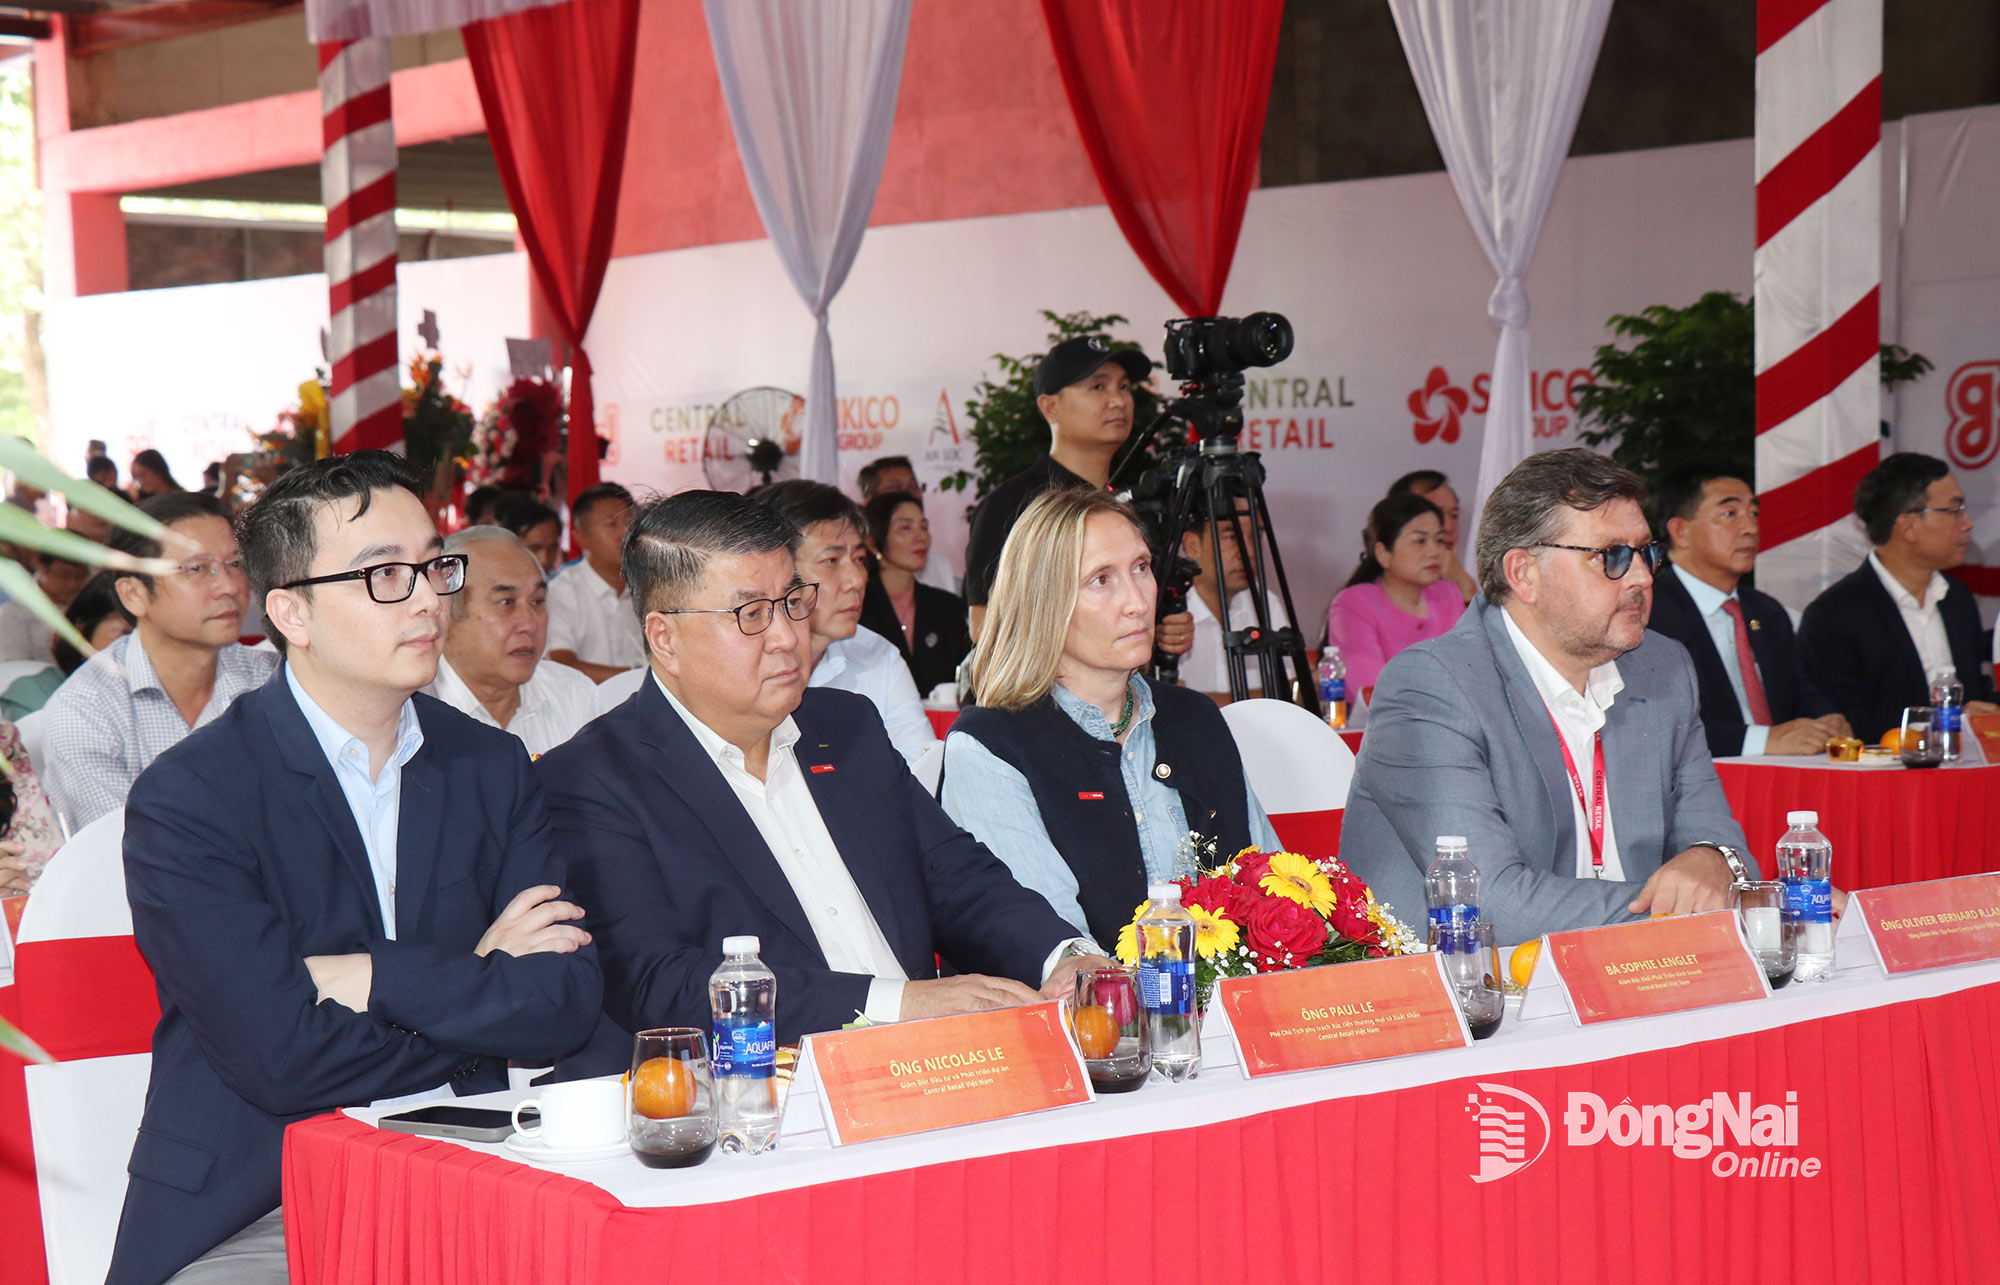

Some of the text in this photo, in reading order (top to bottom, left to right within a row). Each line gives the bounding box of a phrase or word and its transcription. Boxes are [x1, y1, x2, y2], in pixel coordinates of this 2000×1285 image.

[1242, 377, 1355, 409] NTRAL
[1472, 368, 1595, 414] SICO
[650, 404, 745, 432] CENTRAL
[664, 437, 735, 464] RETAIL
[1594, 769, 1603, 830] CENTRAL RETAIL
[1881, 919, 1903, 931] ÔNG
[1902, 915, 1939, 928] OLIVIER
[1936, 909, 1979, 923] BERNARD
[1604, 954, 1699, 975] BÀ SOPHIE LENGLET
[1301, 1001, 1375, 1021] ÔNG PAUL LE
[889, 1046, 1005, 1077] ÔNG NICOLAS LE
